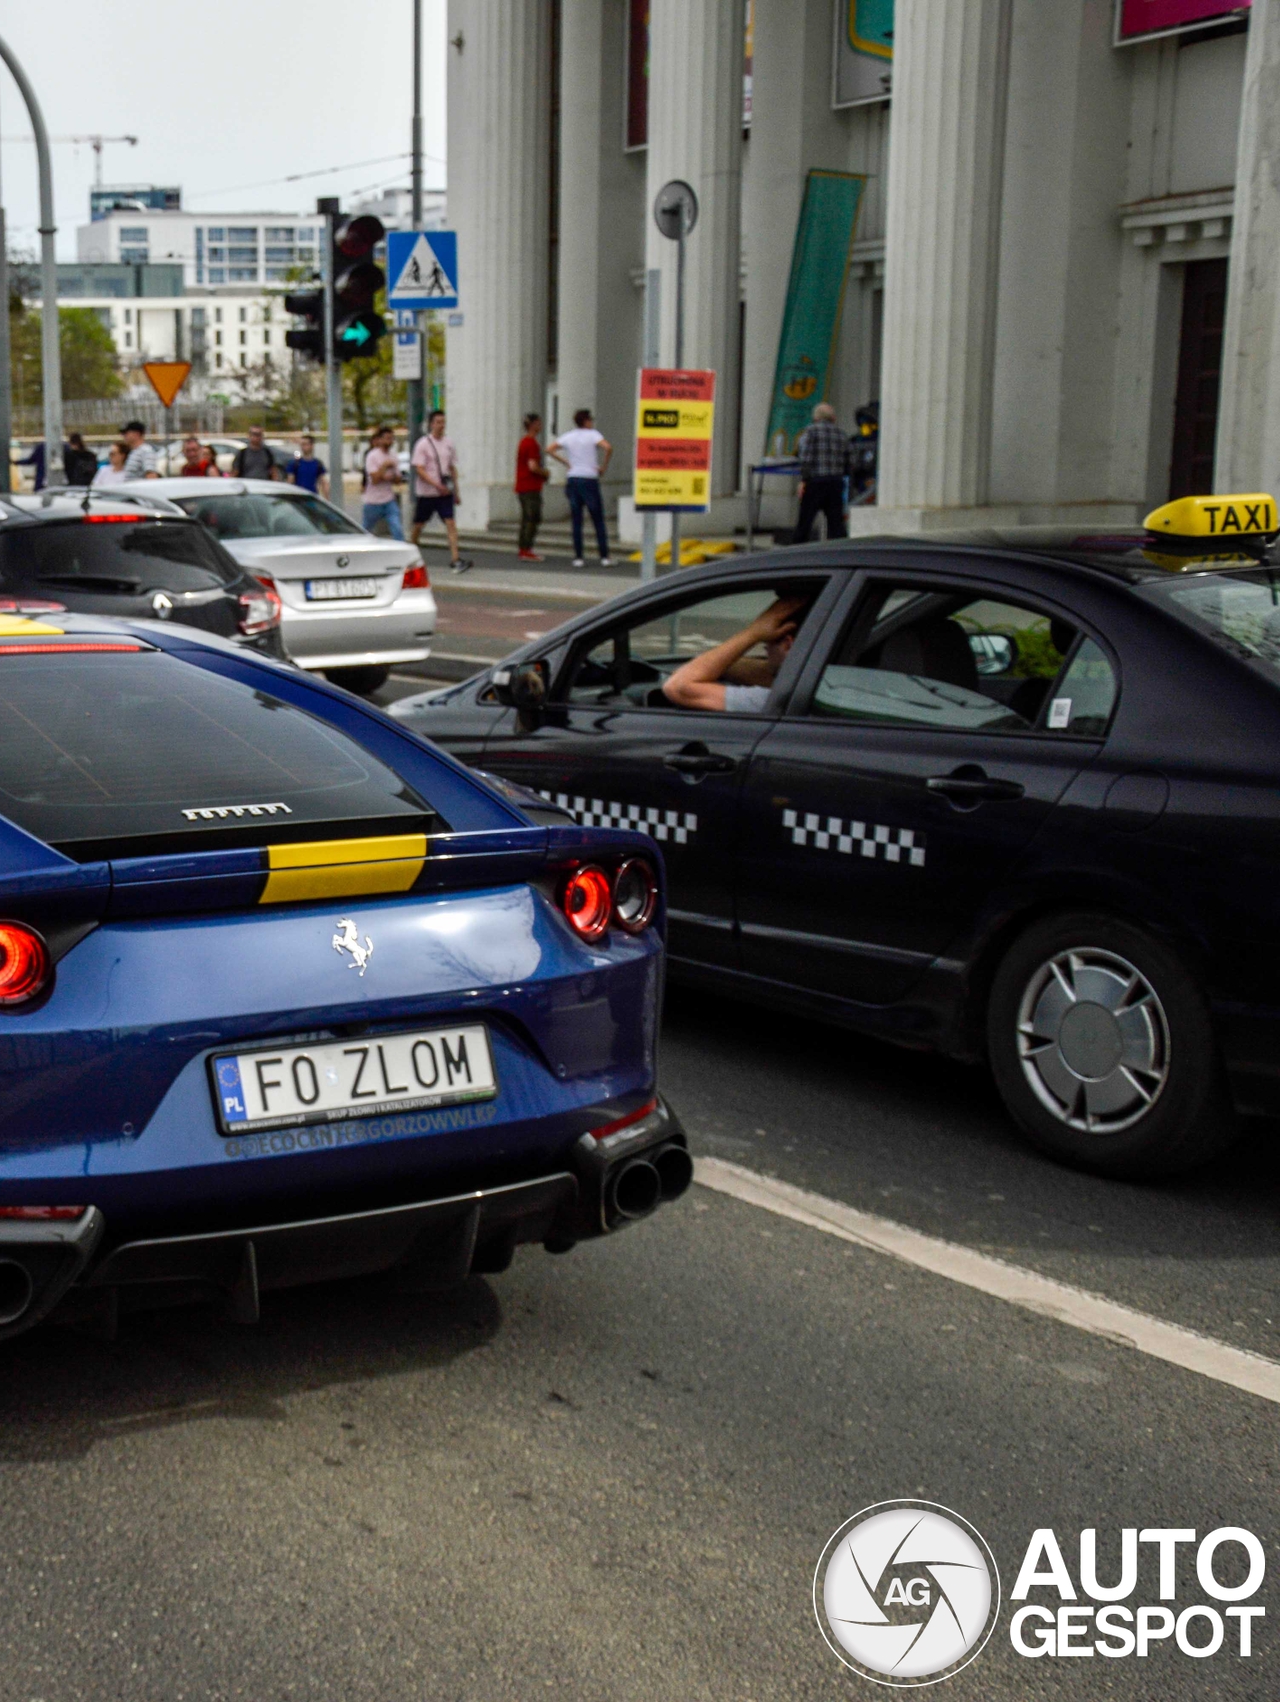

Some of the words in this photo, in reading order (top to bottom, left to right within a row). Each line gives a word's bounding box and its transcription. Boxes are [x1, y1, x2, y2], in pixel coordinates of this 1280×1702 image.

[1203, 504, 1271, 533] TAXI
[343, 1034, 472, 1099] ZLOM
[224, 1097, 244, 1113] PL
